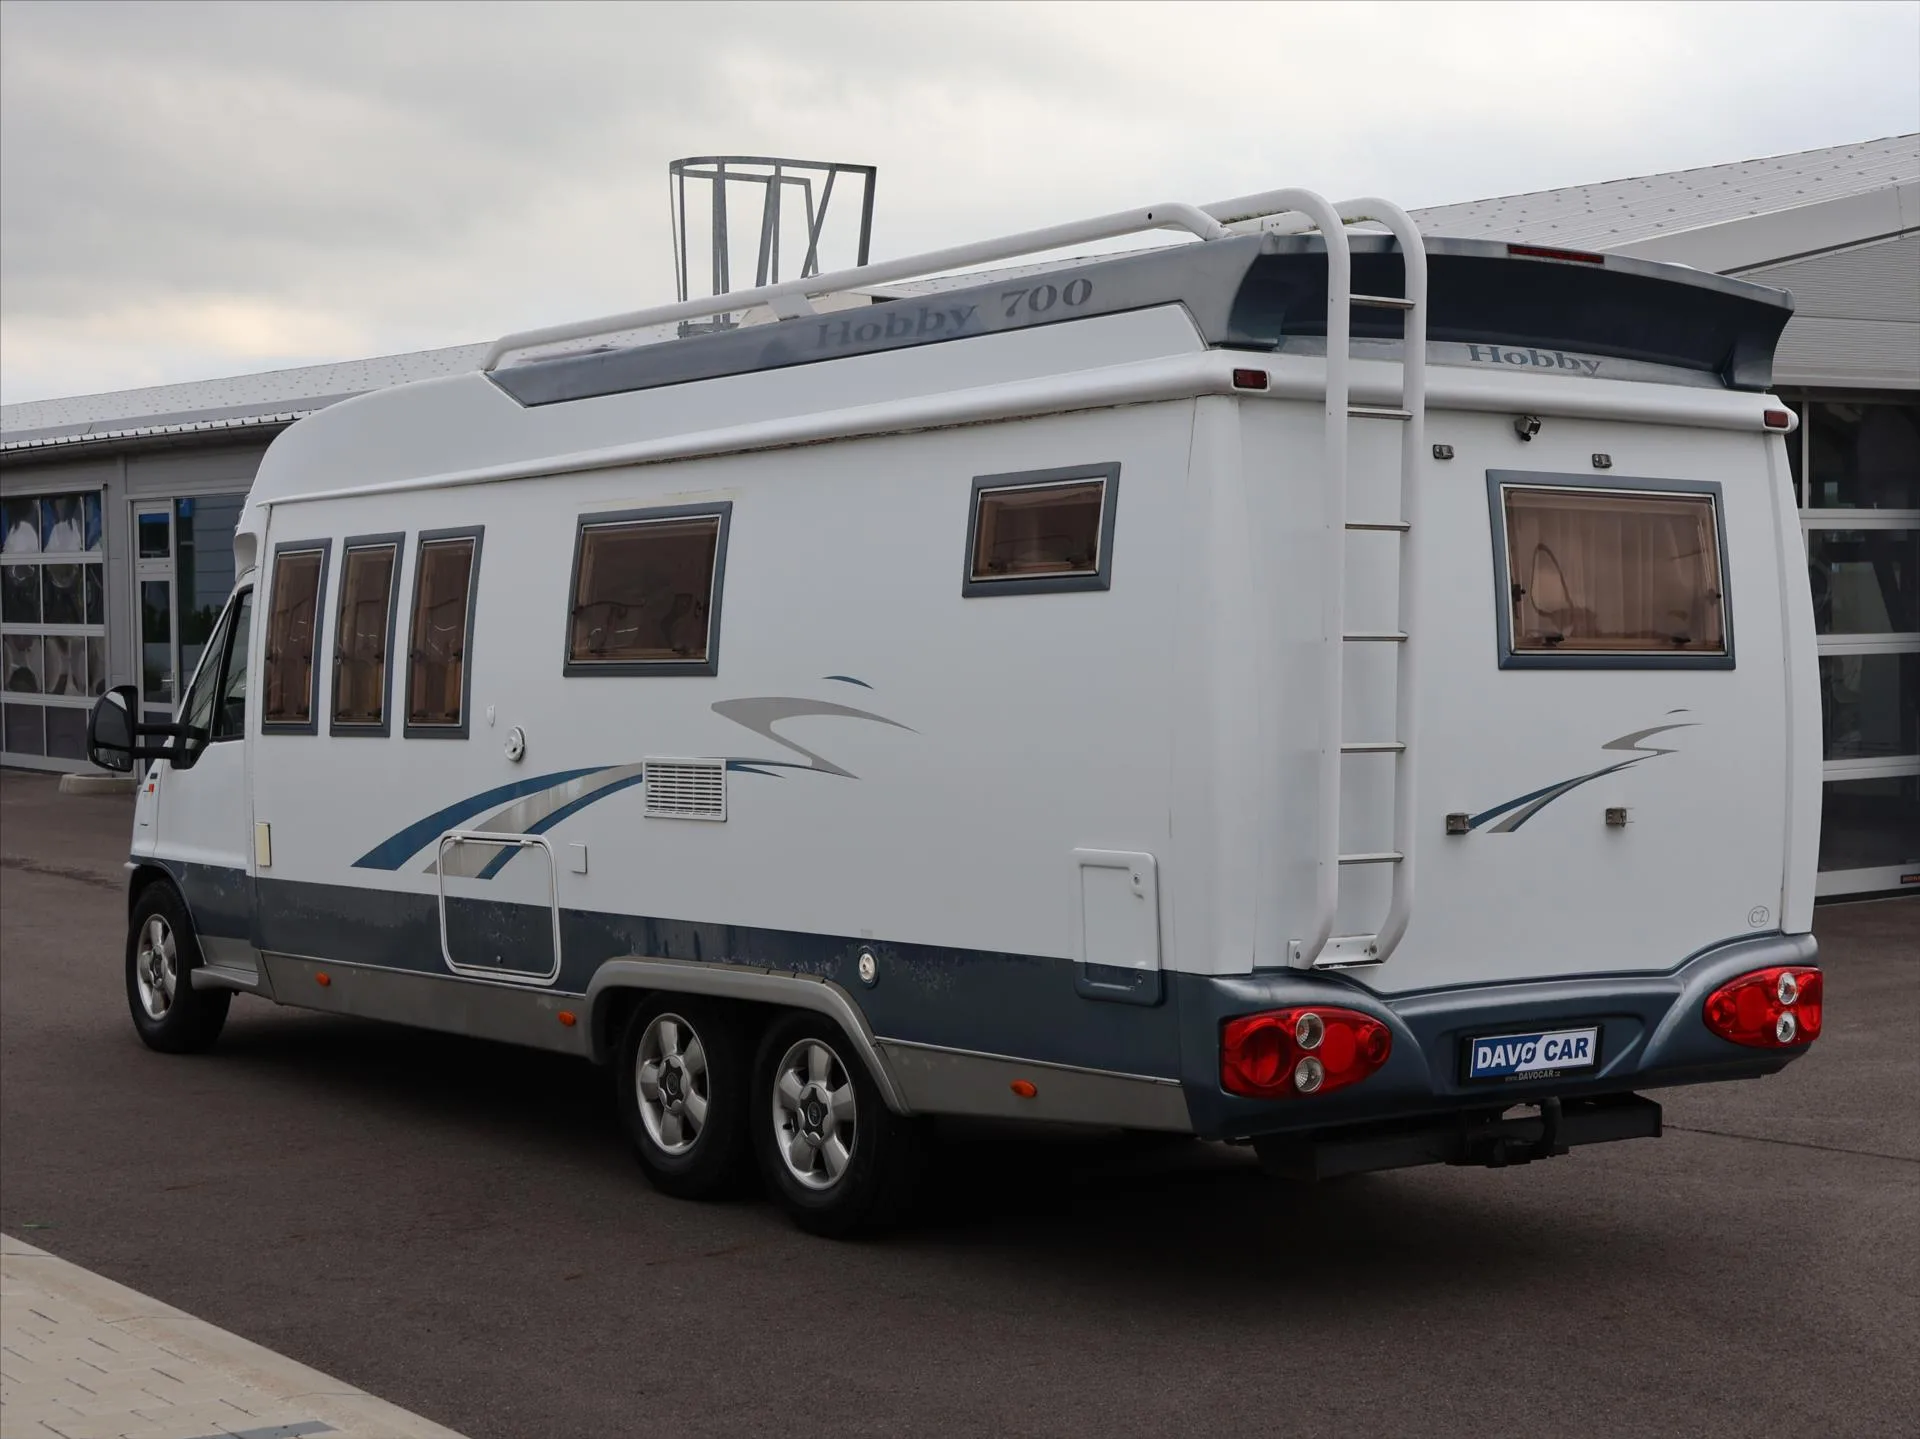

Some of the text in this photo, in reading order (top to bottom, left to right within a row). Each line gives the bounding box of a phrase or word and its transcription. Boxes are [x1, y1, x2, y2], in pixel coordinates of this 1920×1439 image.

[816, 278, 1093, 350] Hobby 700
[1466, 343, 1602, 378] Hobby
[1750, 910, 1766, 923] CZ
[1476, 1037, 1589, 1070] DAVO CAR
